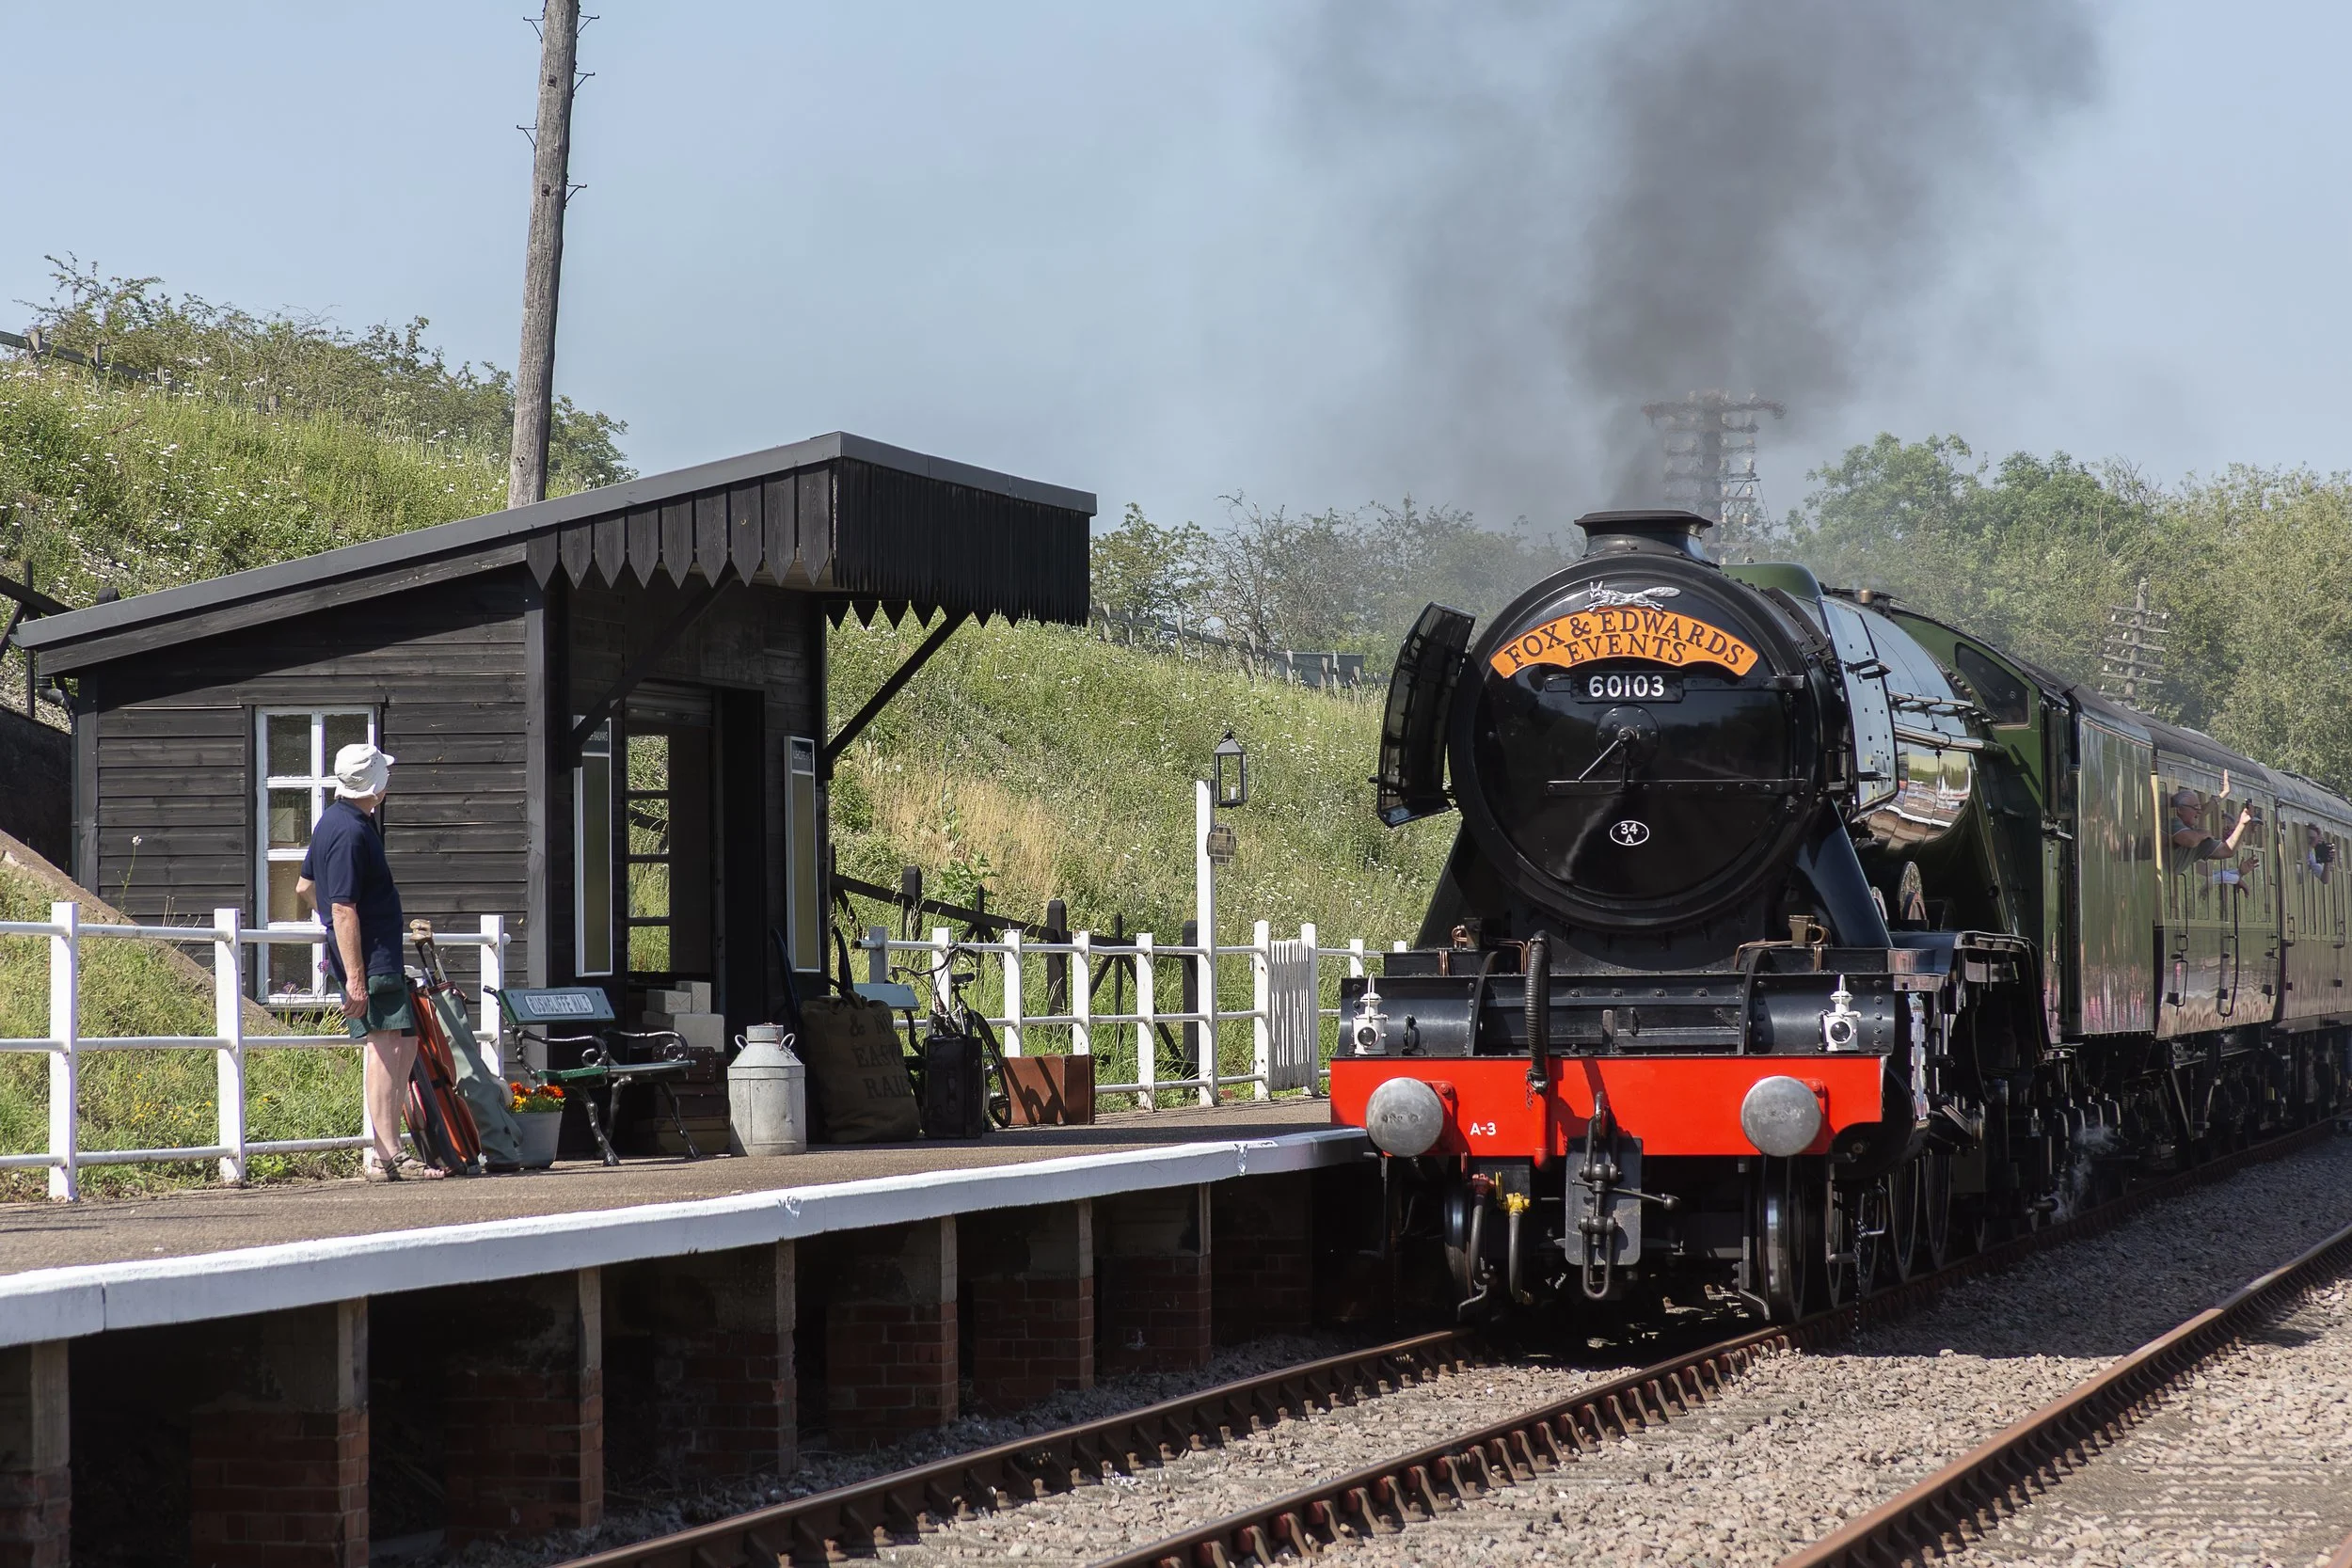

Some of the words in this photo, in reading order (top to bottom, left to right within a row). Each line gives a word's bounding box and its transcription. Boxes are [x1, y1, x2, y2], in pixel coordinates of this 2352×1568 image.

[1504, 624, 1565, 669] FOX
[1569, 617, 1592, 639] &
[1599, 610, 1745, 665] EDWARDS
[1564, 634, 1687, 665] EVENTS
[1589, 675, 1665, 697] 60103
[1620, 823, 1639, 834] 34
[1625, 833, 1634, 844] A
[1470, 1121, 1497, 1136] A-3
